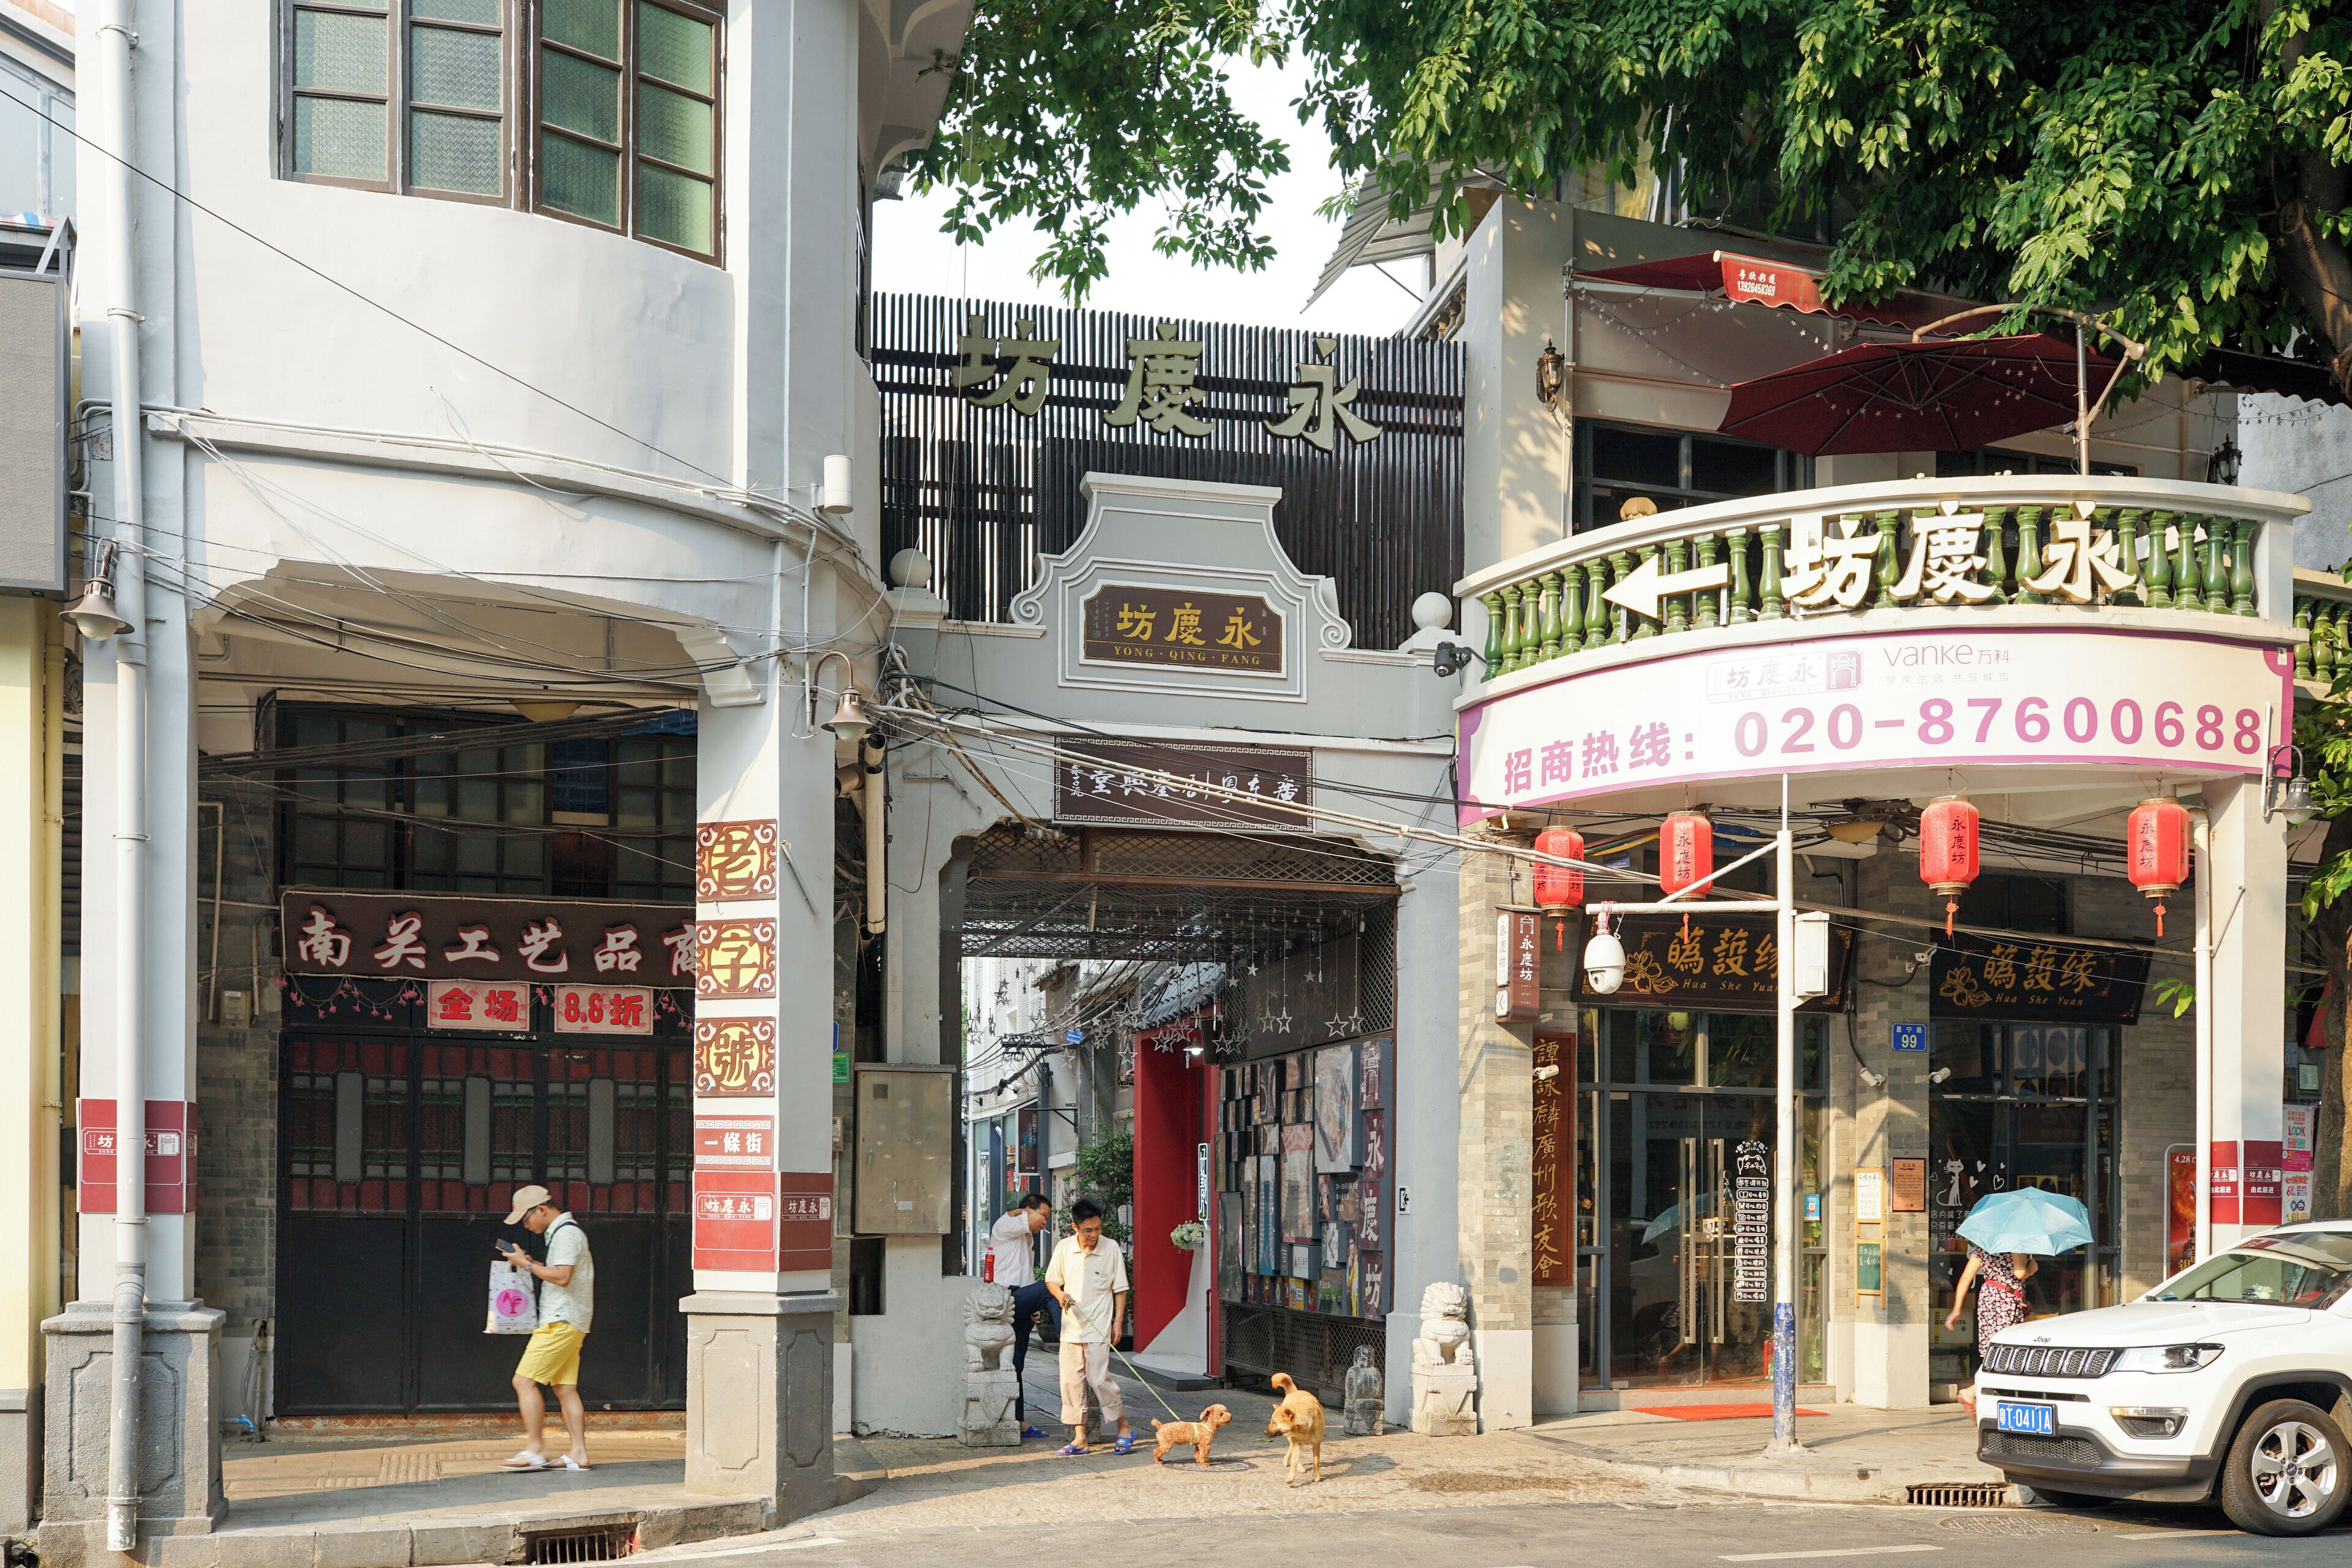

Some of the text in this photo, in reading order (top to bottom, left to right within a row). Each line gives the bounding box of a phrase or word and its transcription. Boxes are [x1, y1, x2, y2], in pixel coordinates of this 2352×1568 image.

[1737, 281, 1776, 296] 13926458369
[1114, 646, 1261, 666] YONG QING FANG
[1977, 649, 2010, 665] 万科
[1735, 697, 2260, 756] 020-87600688
[1683, 979, 1707, 990] Hua
[1721, 980, 1741, 990] She
[438, 987, 518, 1023] 全场
[1996, 993, 2083, 1006] Hua She Yuan
[1901, 1035, 1917, 1048] 99
[704, 1132, 762, 1153] 一條街
[2034, 1335, 2051, 1344] Jeep
